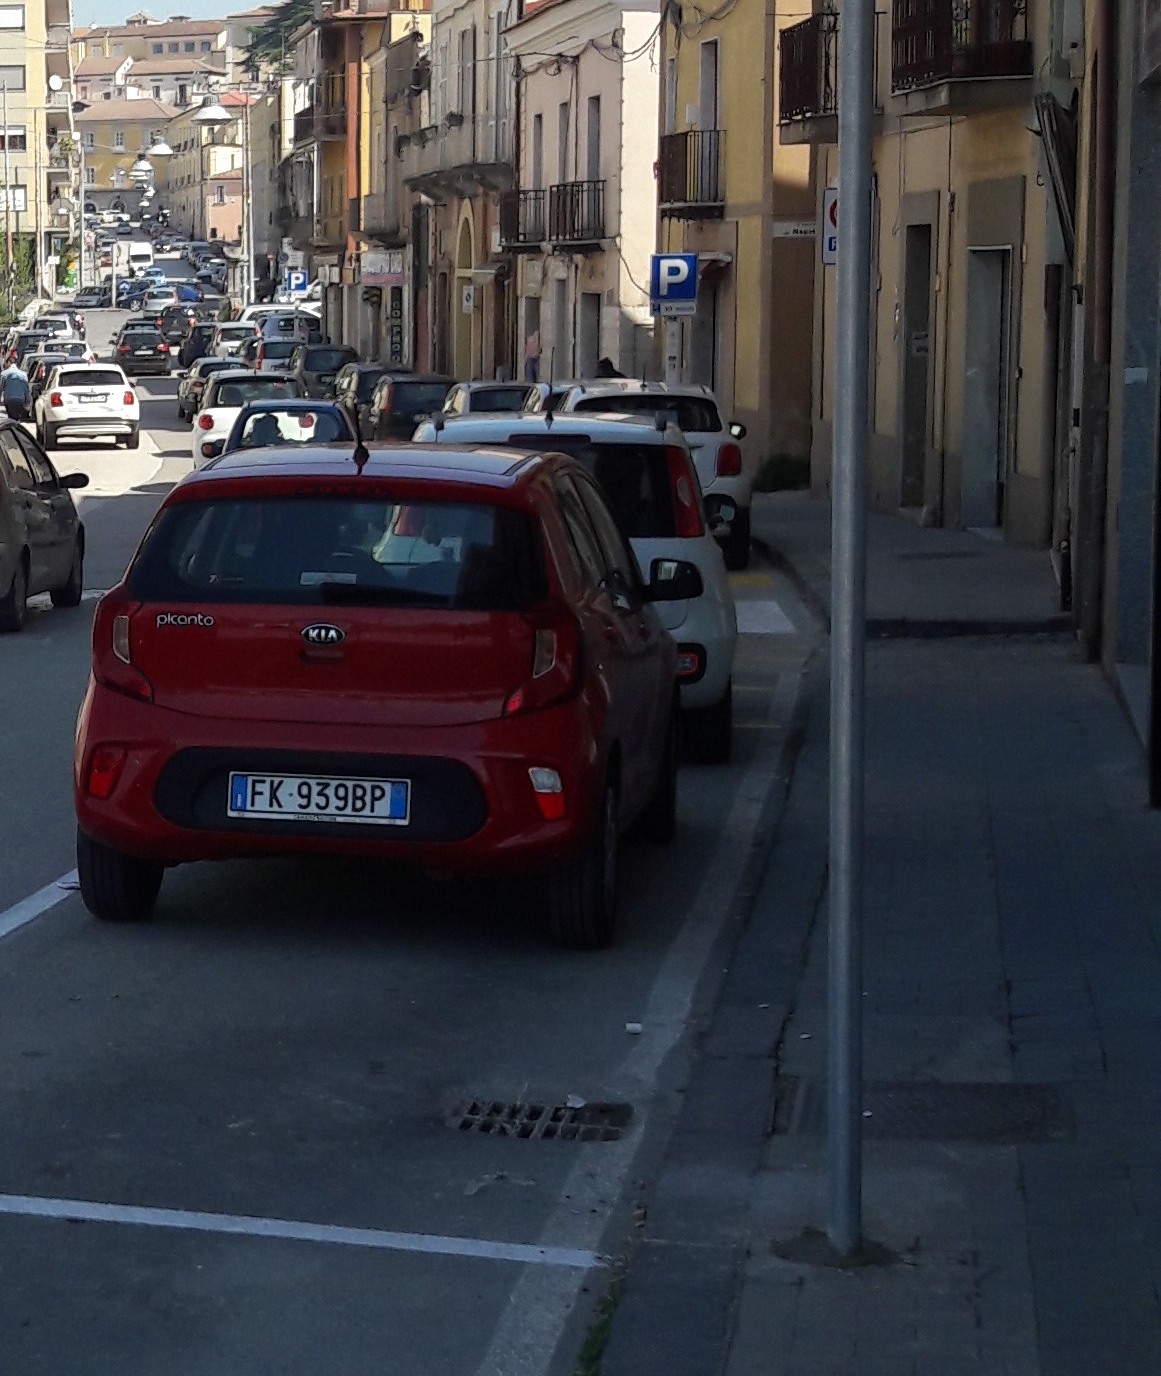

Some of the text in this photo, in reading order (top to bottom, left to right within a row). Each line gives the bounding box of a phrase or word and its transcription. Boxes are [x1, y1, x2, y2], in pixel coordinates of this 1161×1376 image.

[290, 272, 304, 290] P
[658, 258, 689, 296] P
[156, 612, 215, 628] picanto
[308, 627, 339, 643] KIA
[250, 779, 386, 814] FK 939BP
